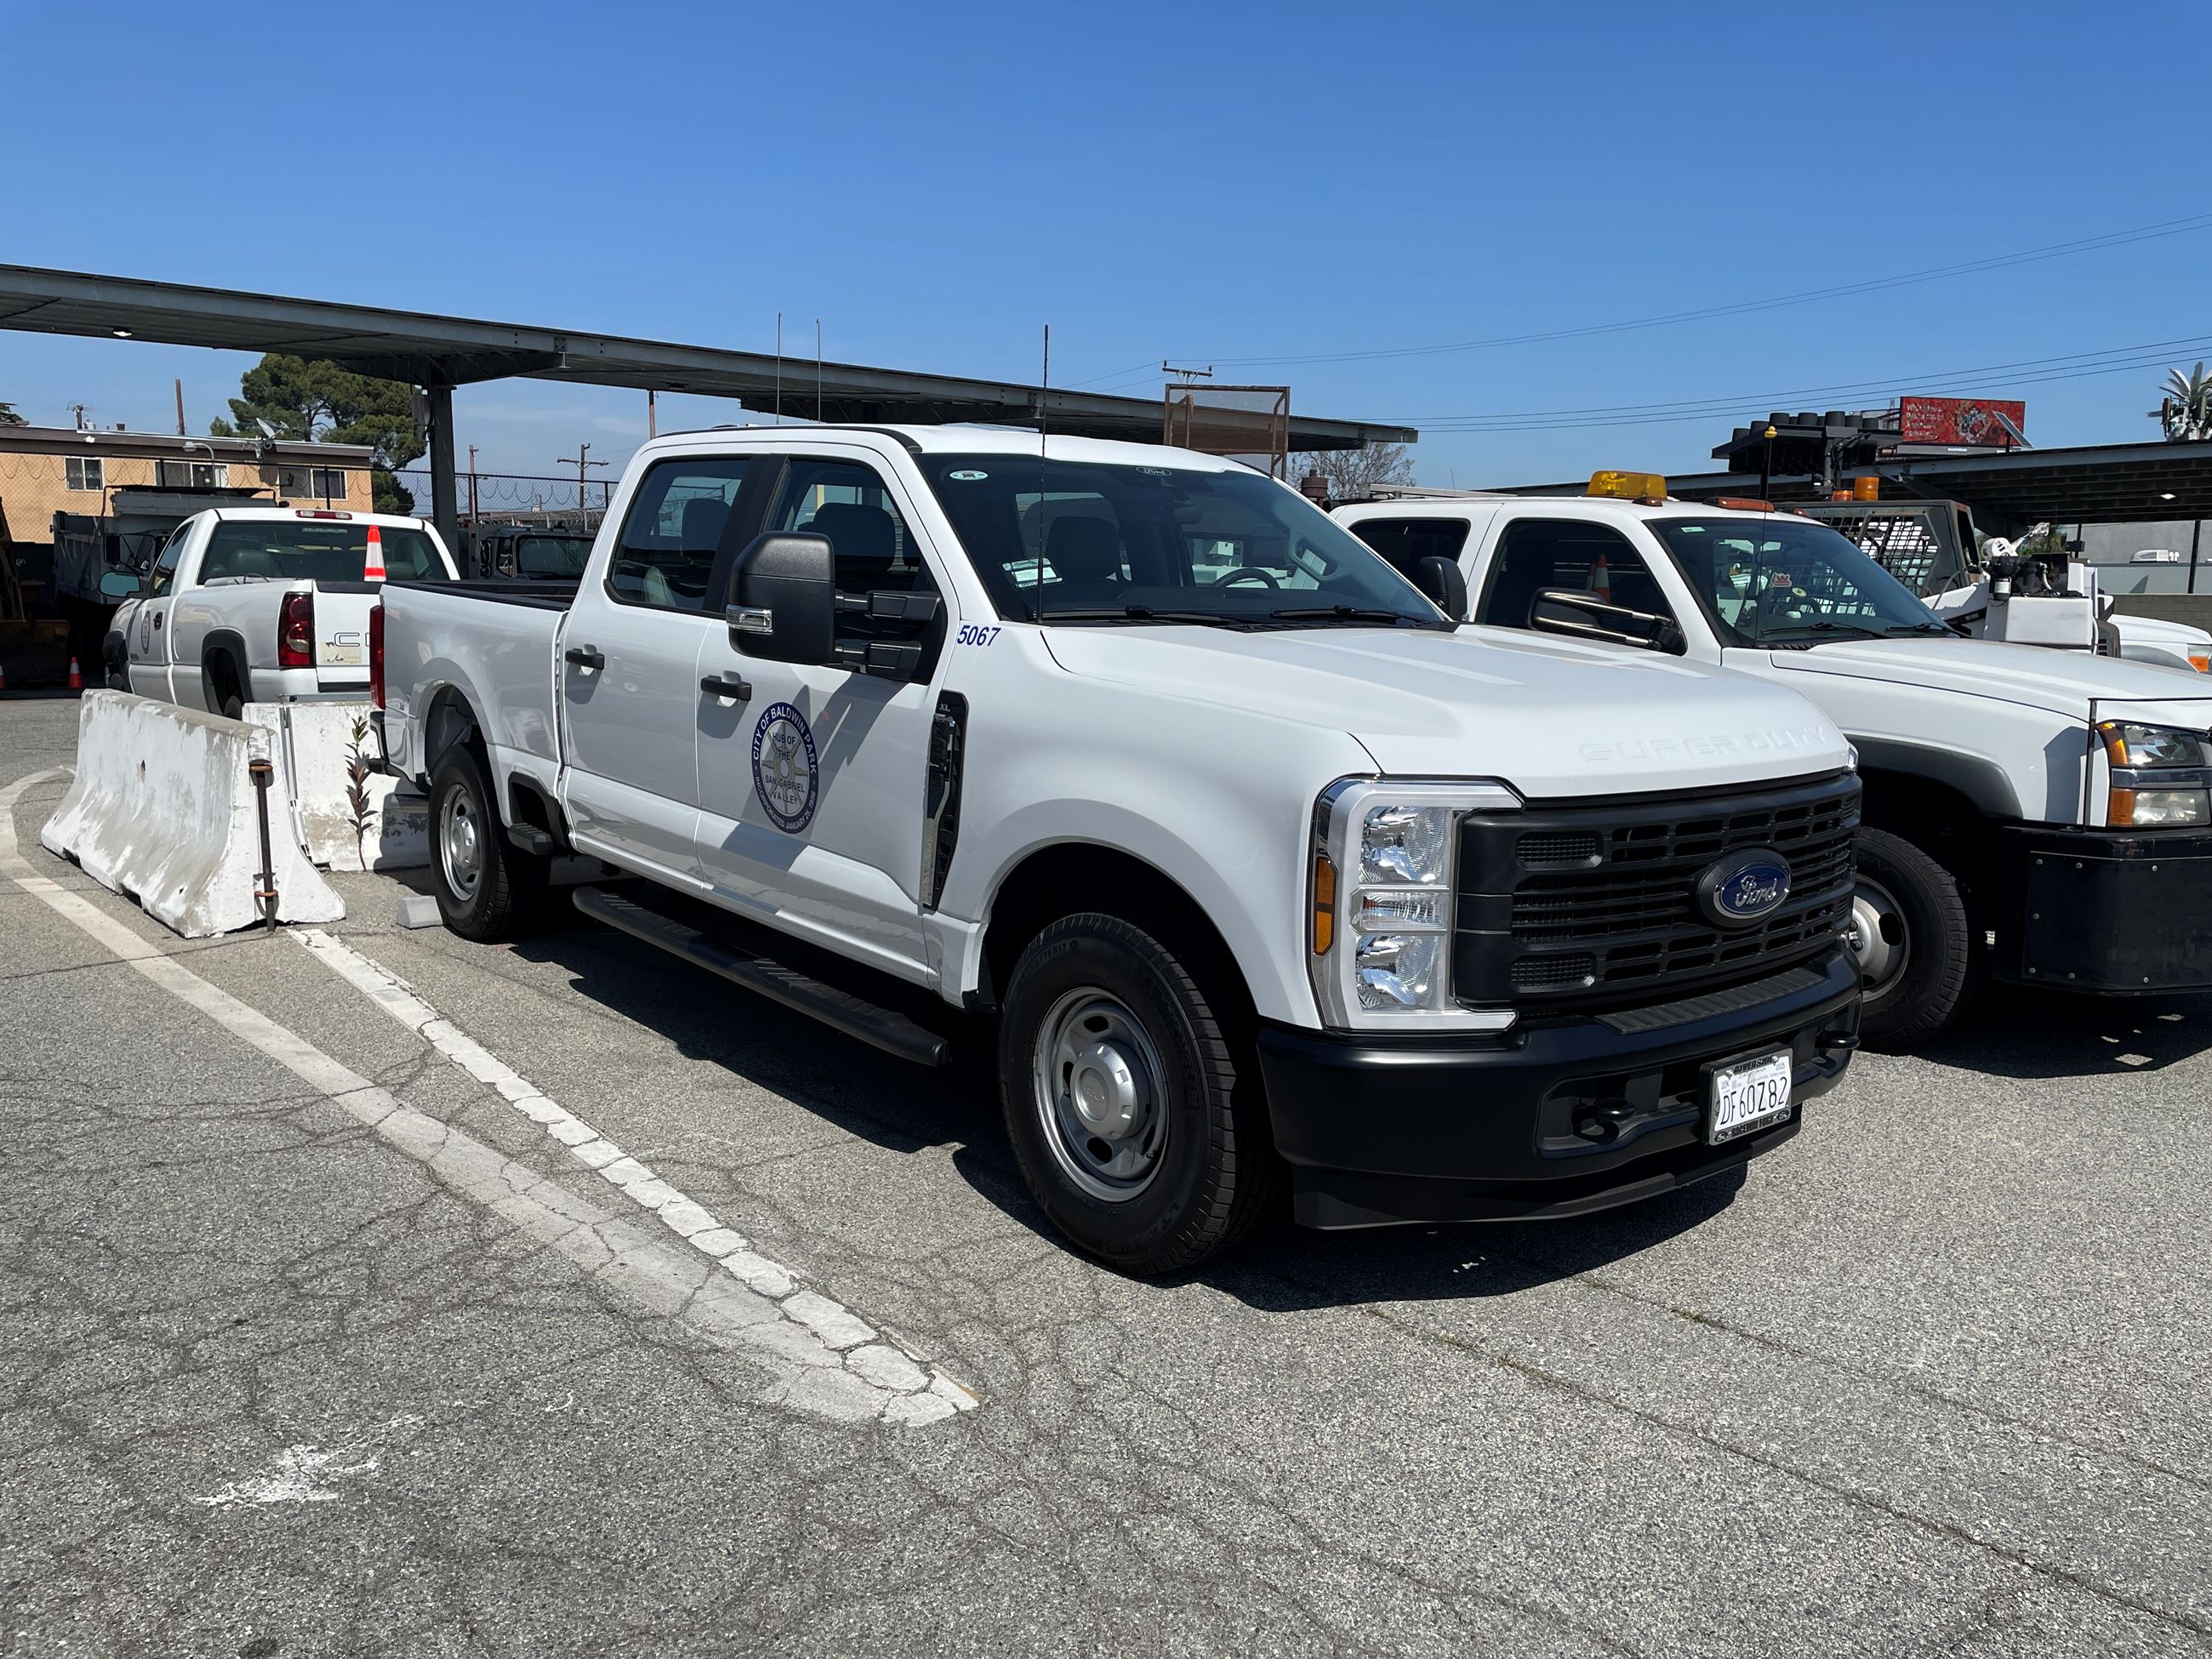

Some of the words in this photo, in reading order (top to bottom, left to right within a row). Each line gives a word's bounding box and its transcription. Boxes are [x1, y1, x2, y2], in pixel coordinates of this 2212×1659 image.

[957, 624, 1001, 647] 5067
[939, 703, 951, 712] XL
[753, 732, 762, 761] CITY
[761, 714, 770, 730] OF
[770, 706, 806, 734] BALDWIN
[804, 733, 818, 774] PARK
[772, 733, 786, 744] HUB
[786, 735, 795, 745] OF
[1580, 735, 1739, 763] SUPER
[1746, 726, 1827, 750] DUTY
[778, 750, 790, 761] THE
[765, 775, 777, 786] SAN
[778, 778, 805, 794] GABRIEL
[772, 790, 800, 805] VALLEY
[1735, 875, 1778, 908] Ford
[1734, 1056, 1774, 1074] RIVERSIDE
[1719, 1076, 1788, 1126] DF60Z82
[1731, 1118, 1759, 1137] RACEWAY
[1759, 1115, 1775, 1128] FORD
